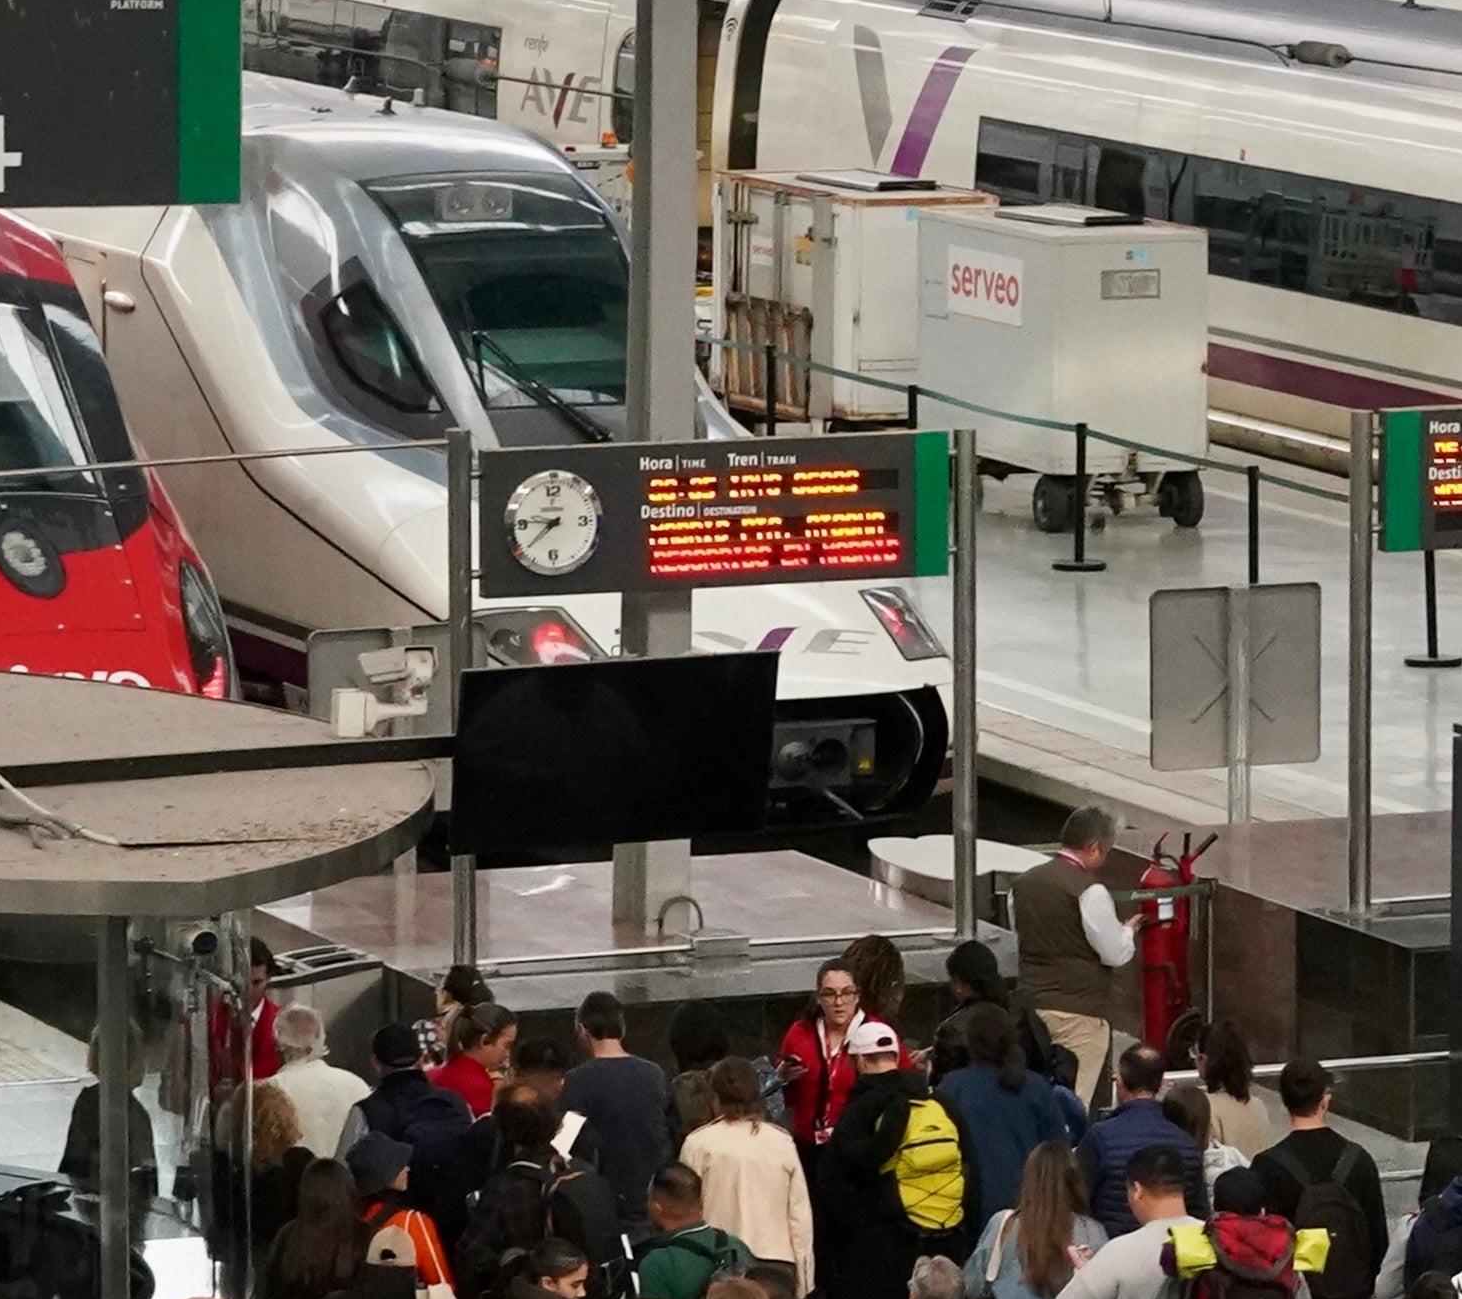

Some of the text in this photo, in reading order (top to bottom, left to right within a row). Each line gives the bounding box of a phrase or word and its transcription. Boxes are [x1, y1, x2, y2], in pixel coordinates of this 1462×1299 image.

[110, 0, 164, 10] PLATFORM
[520, 66, 602, 129] AVE
[950, 263, 1019, 307] serveo
[1429, 421, 1461, 434] Hora
[639, 452, 796, 470] Hora TIME Tren TRAIN
[545, 485, 561, 498] 12
[641, 504, 695, 519] Destino
[578, 515, 589, 527] 3
[548, 548, 559, 562] 6
